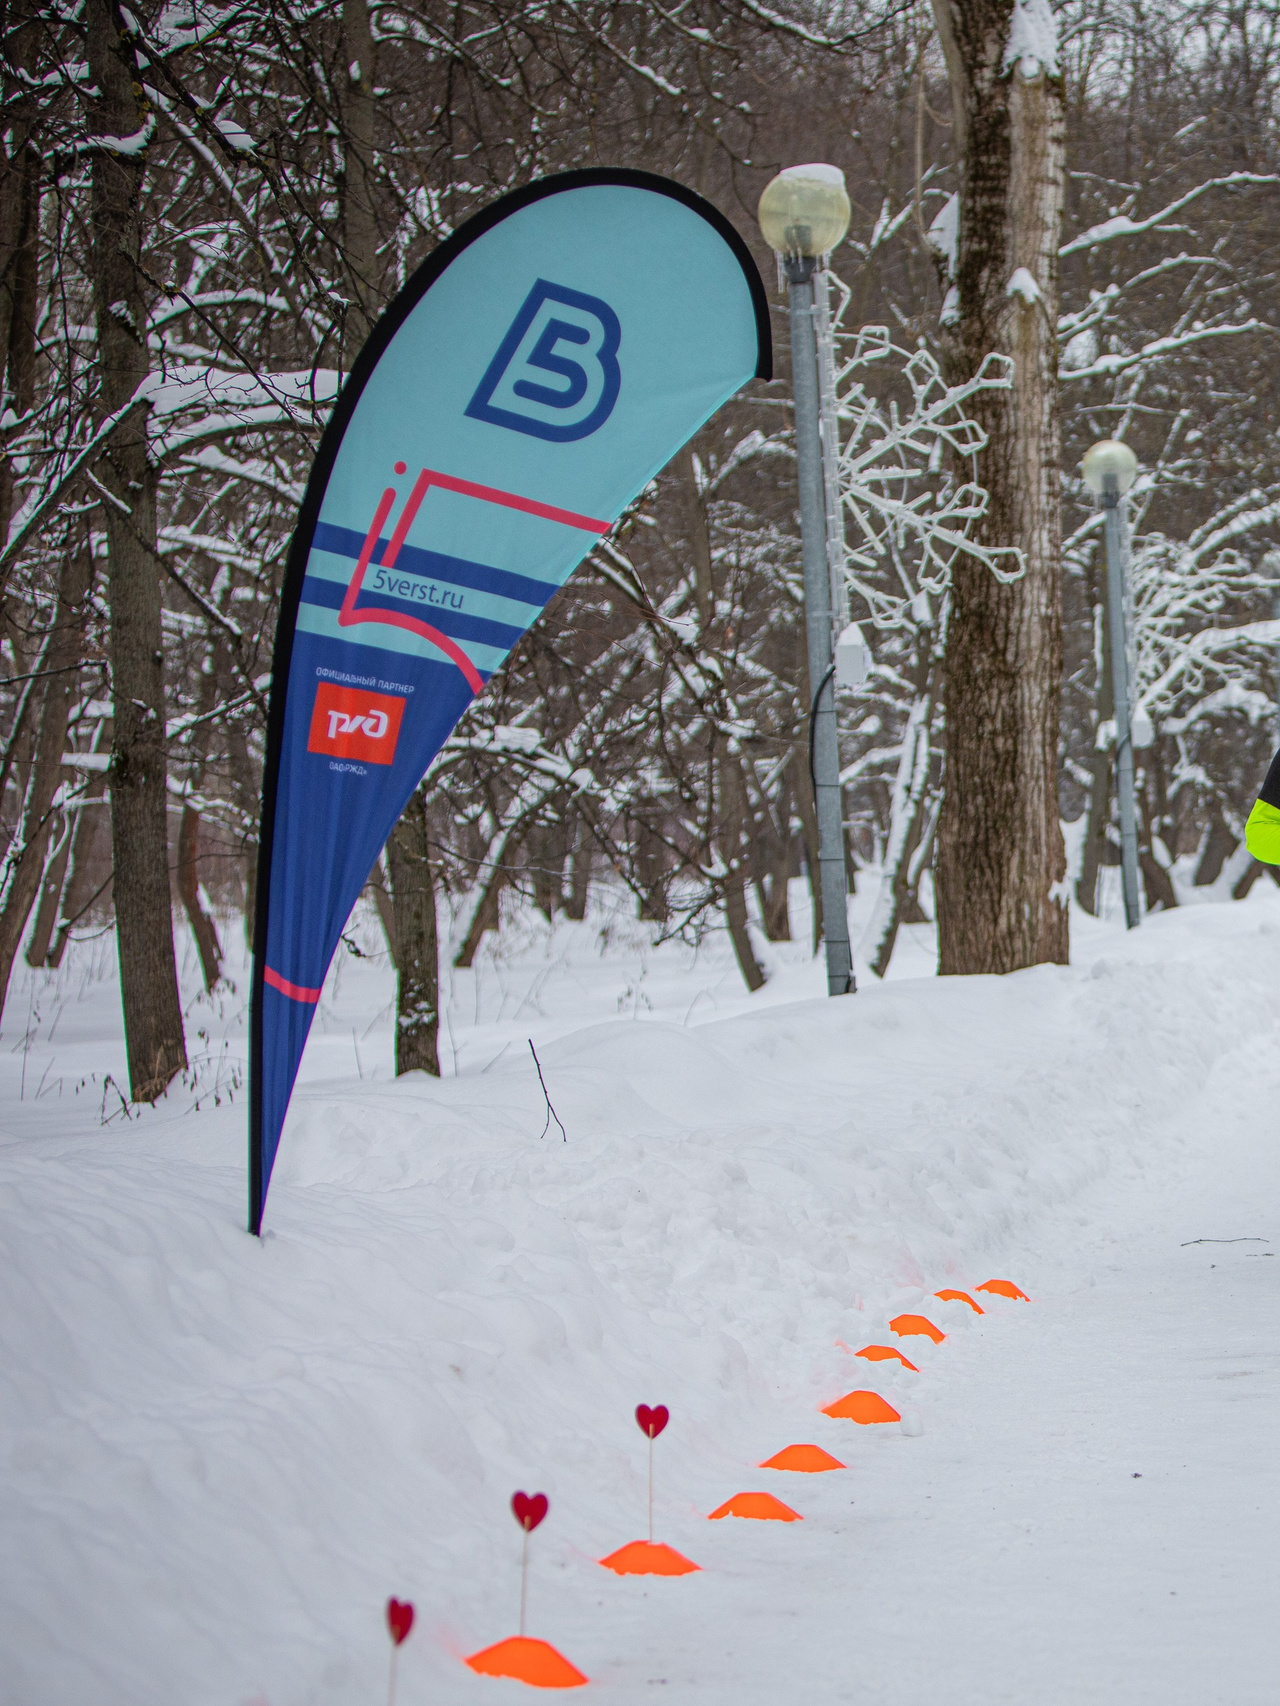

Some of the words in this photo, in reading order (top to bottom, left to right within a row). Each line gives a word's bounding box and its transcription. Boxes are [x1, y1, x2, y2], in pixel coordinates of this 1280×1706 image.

[372, 569, 464, 609] 5verst.ru
[316, 667, 376, 687] ОФИЦИАЛЬНЫЙ
[378, 680, 415, 693] ПАРТНЕР
